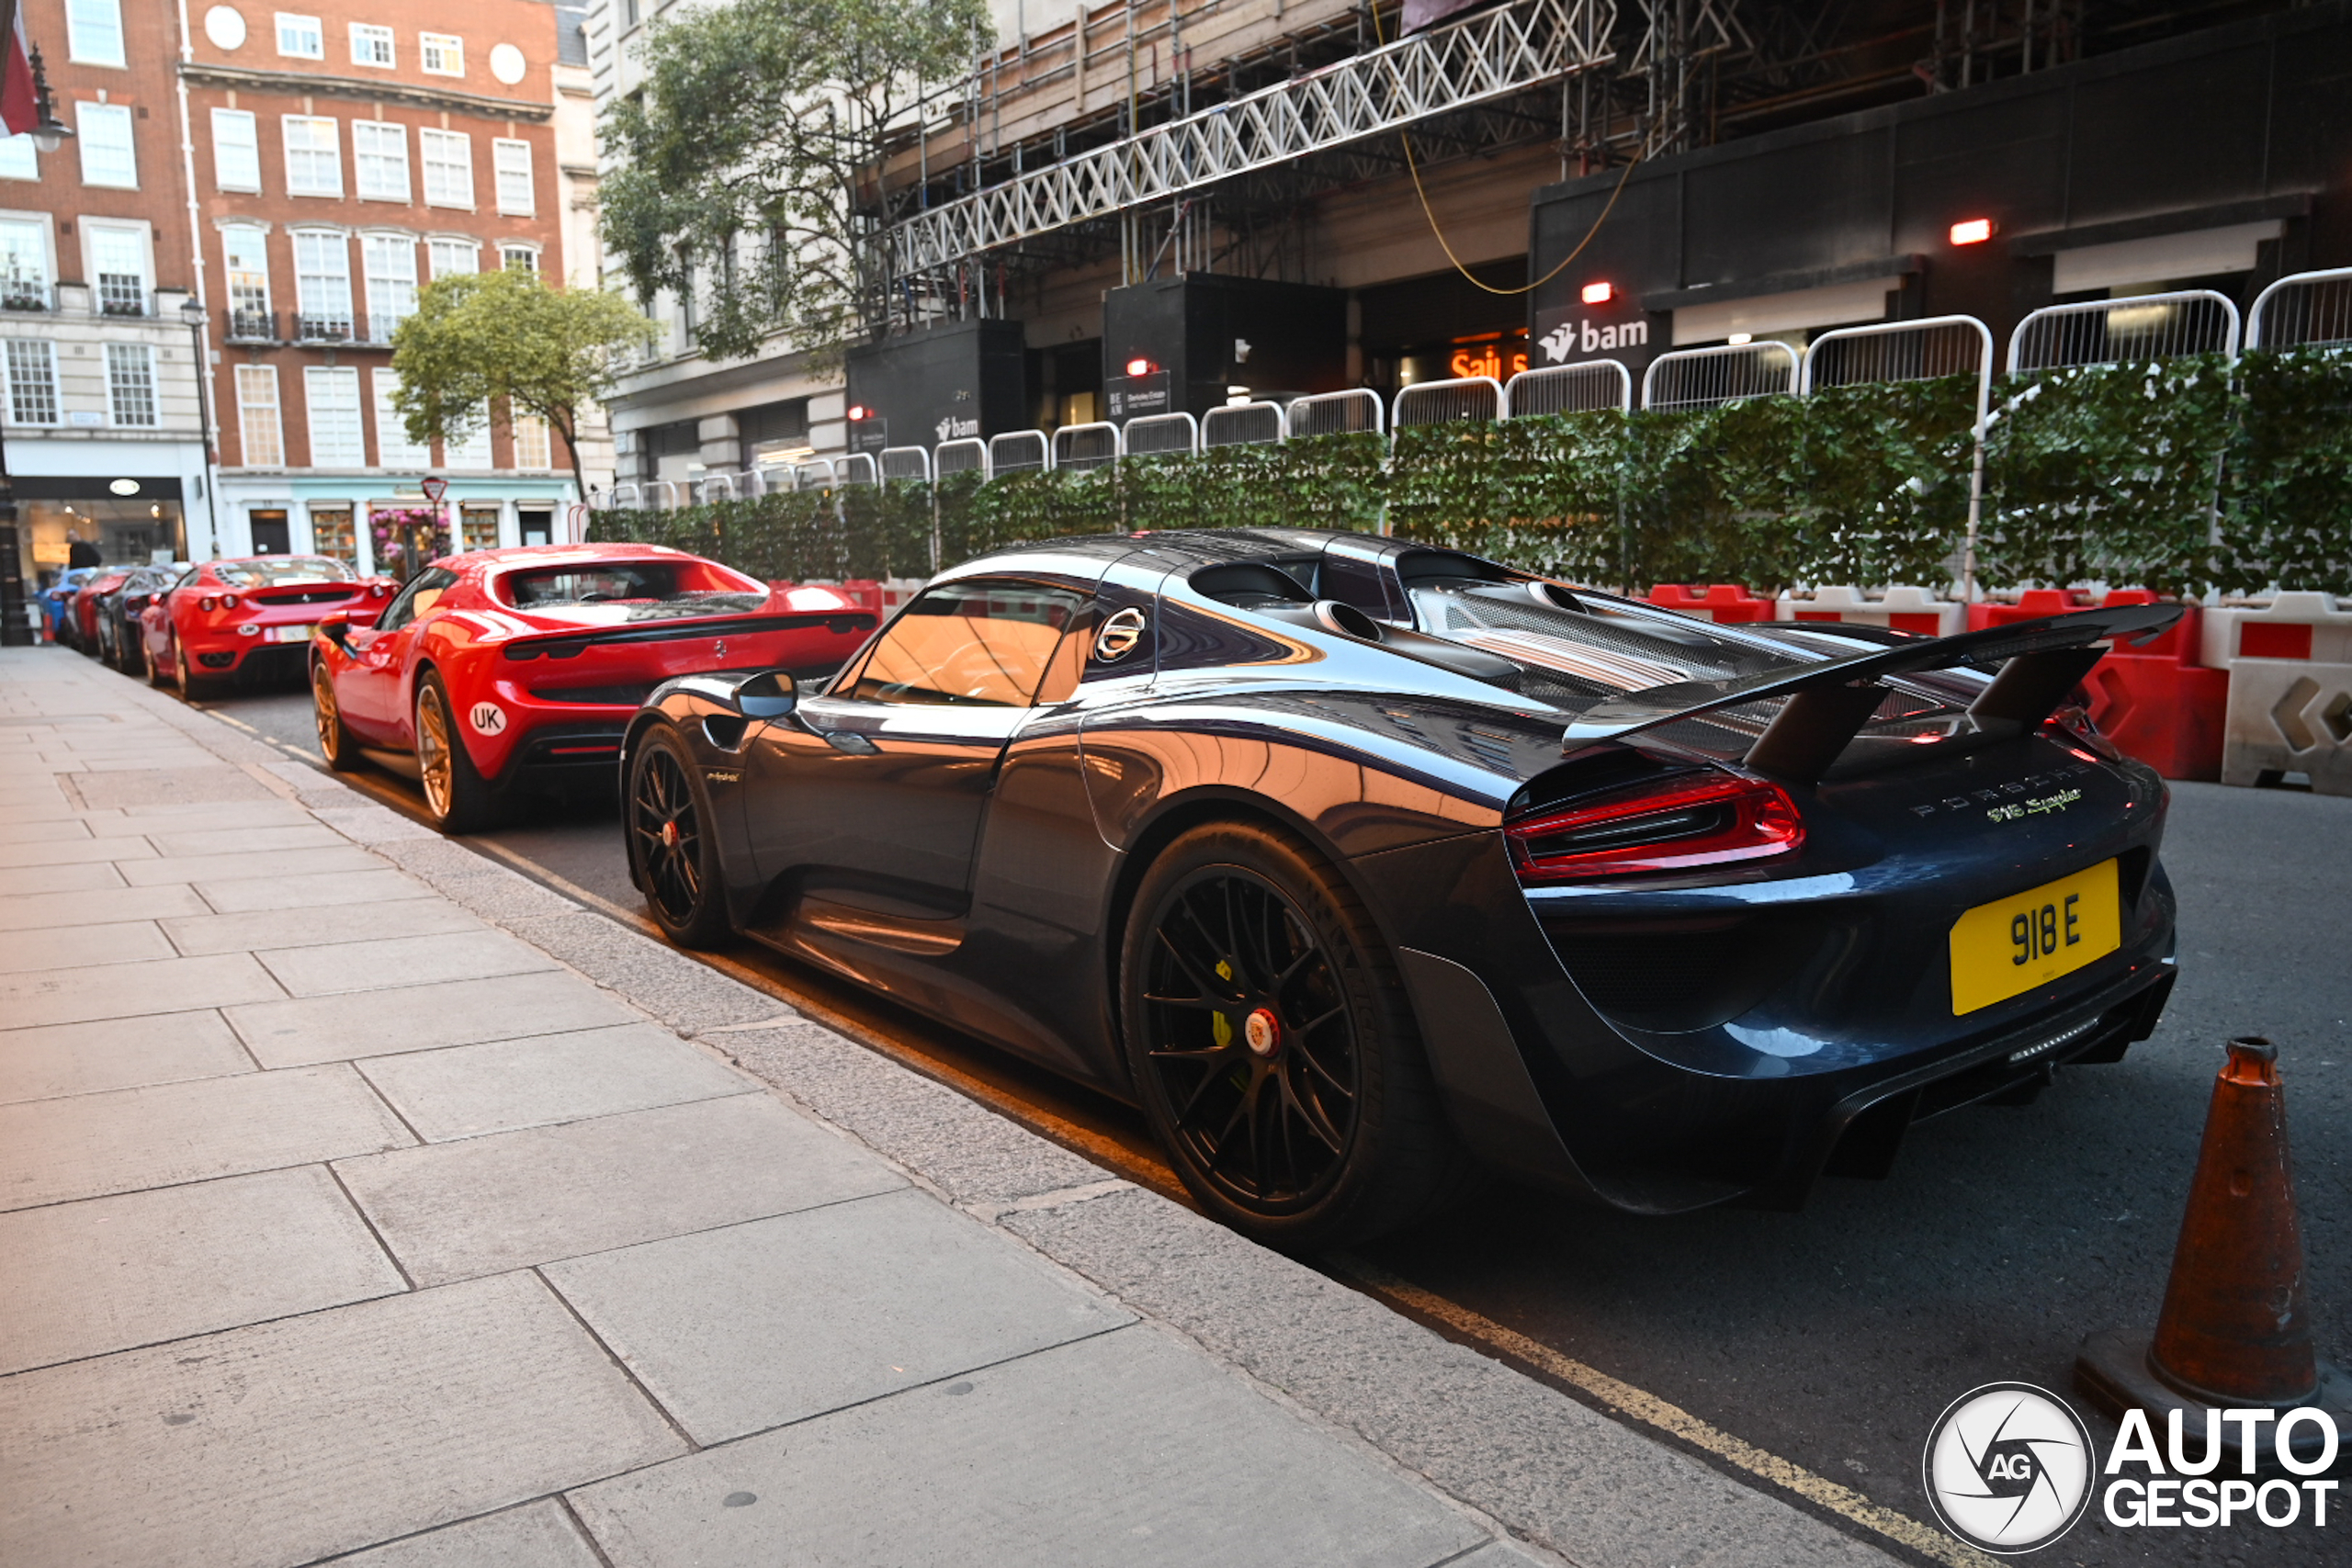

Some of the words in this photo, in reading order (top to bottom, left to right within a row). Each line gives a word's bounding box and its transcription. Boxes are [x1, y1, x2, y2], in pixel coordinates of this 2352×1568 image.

[1581, 319, 1648, 353] bam
[952, 416, 978, 437] bam
[474, 708, 501, 729] UK
[1909, 763, 2090, 818] PORSCHE
[2010, 903, 2058, 966] 918
[2064, 893, 2081, 947] E
